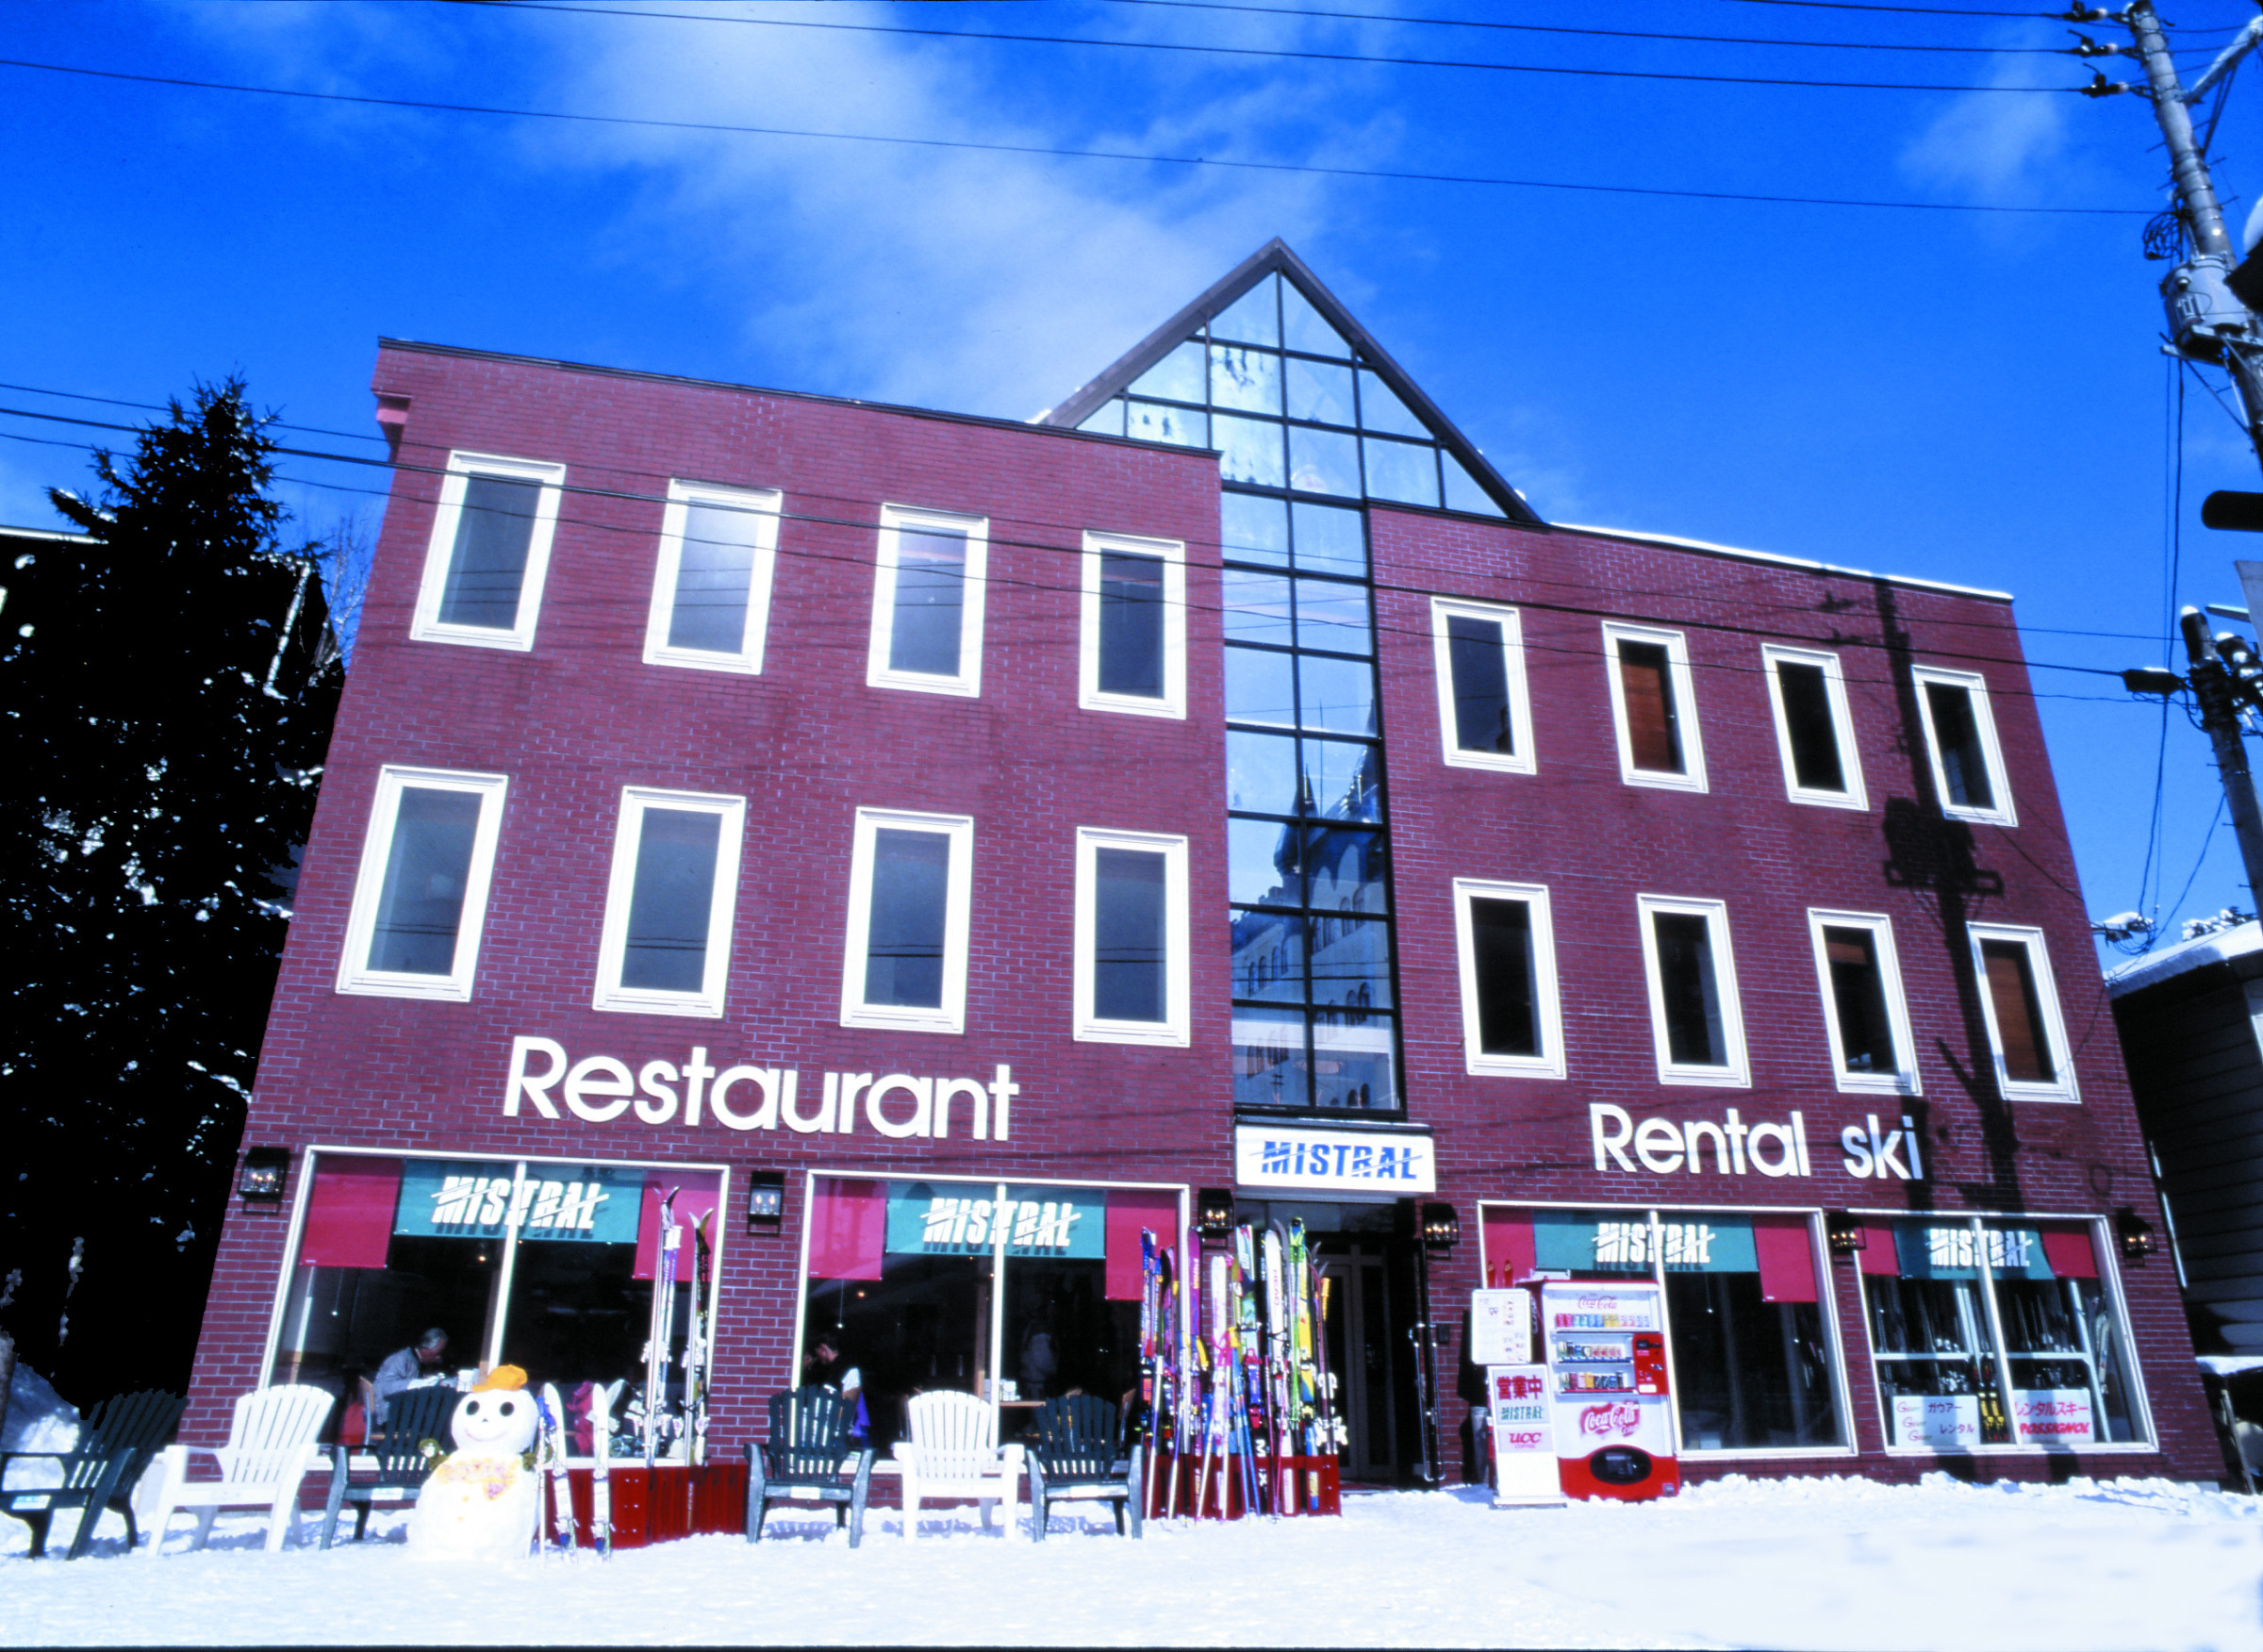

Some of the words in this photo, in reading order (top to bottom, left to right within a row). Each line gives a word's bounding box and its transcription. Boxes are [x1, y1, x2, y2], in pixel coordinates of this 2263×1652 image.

[504, 1035, 1019, 1141] Restaurant
[1260, 1140, 1419, 1181] MISTRAL
[1589, 1102, 1811, 1177] Rental
[1842, 1114, 1924, 1180] ski
[431, 1176, 603, 1230] MISTRAL
[921, 1198, 1076, 1247] MISTRAL
[1594, 1222, 1712, 1264] MISTRAL
[1496, 1374, 1544, 1400] 営業中
[2014, 1400, 2090, 1416] レンタルスキー
